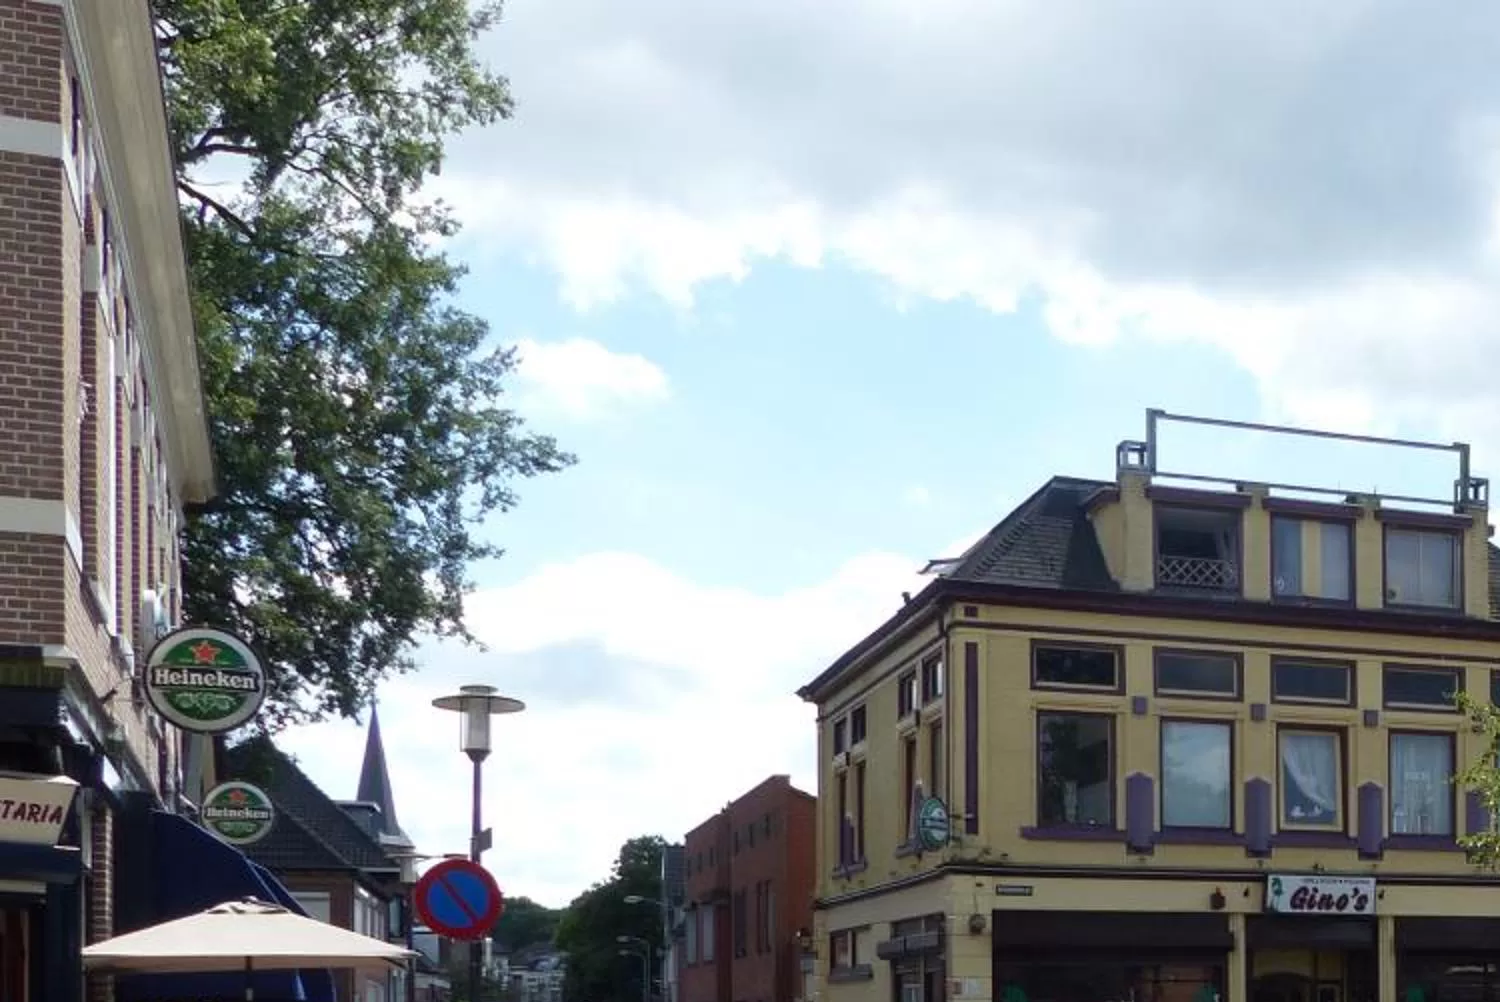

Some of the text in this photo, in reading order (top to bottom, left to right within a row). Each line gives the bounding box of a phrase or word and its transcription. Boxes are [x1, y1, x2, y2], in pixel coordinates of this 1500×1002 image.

[154, 667, 256, 689] Heineken
[0, 799, 64, 825] TARIA
[1289, 886, 1369, 911] Gino's
